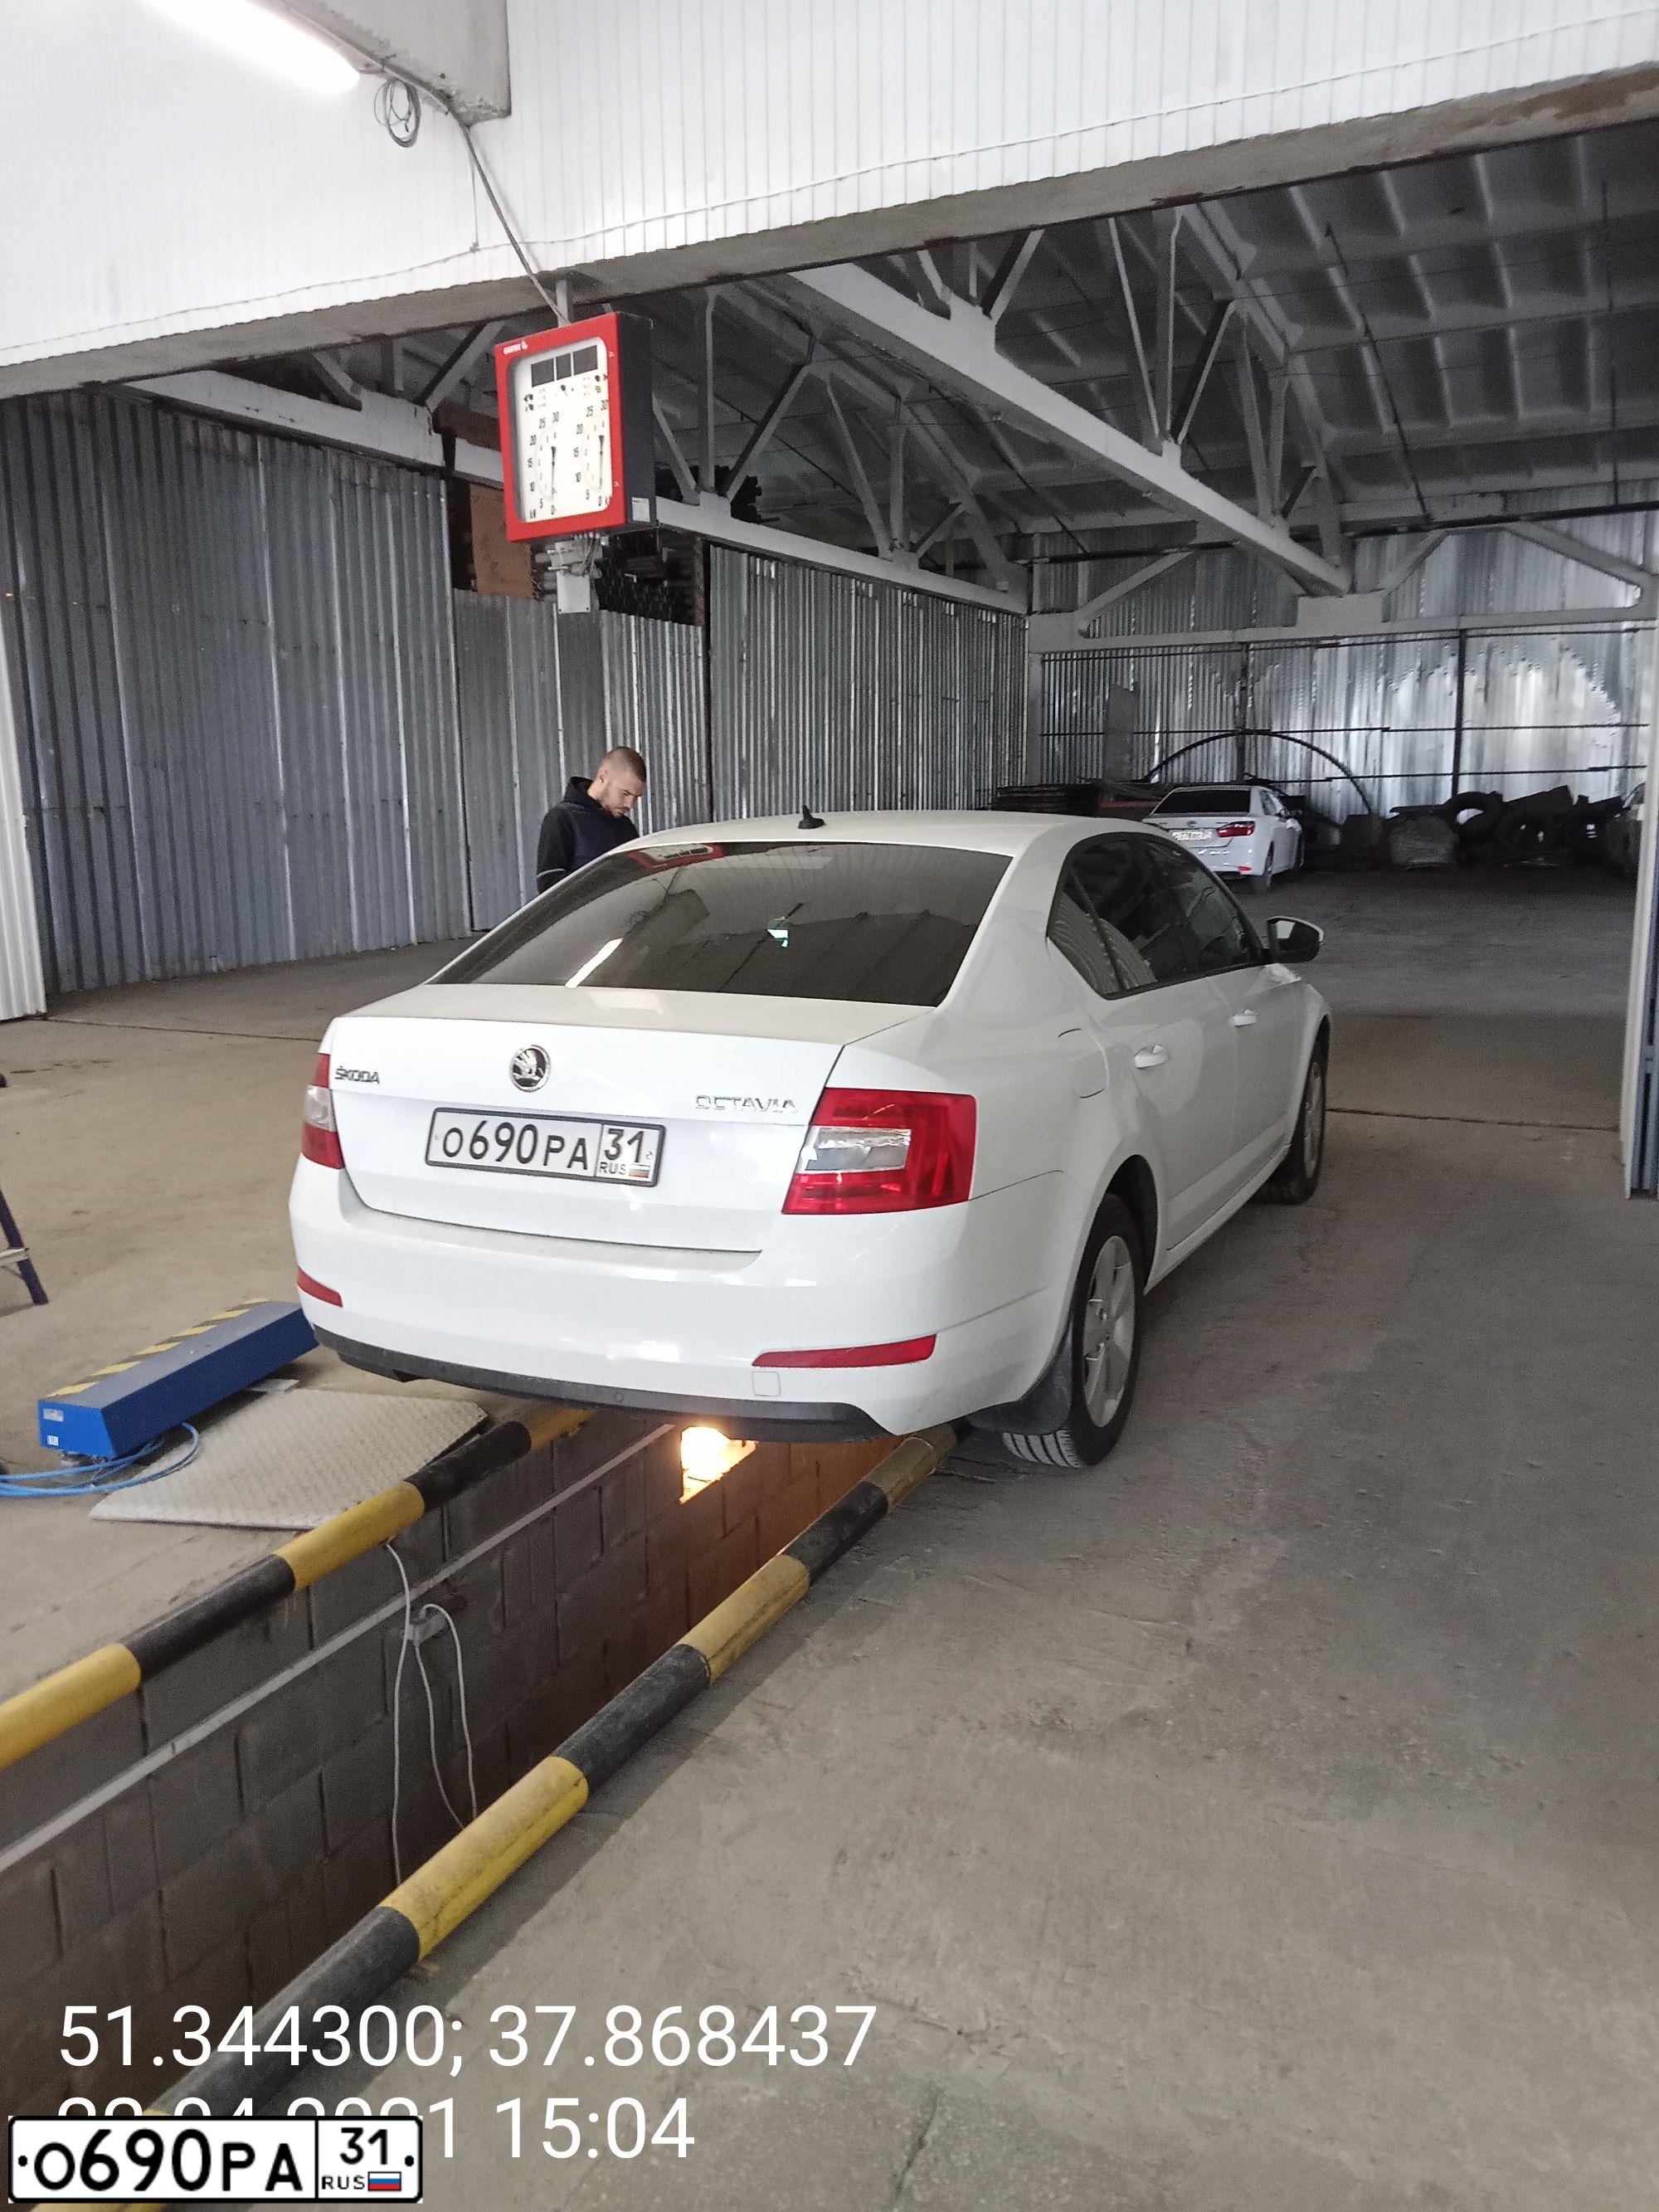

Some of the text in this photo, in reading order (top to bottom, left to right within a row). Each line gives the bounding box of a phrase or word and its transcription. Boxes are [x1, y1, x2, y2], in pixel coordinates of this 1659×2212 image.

[695, 1094, 798, 1113] OCTAVIA
[443, 1120, 645, 1170] О690РА 31
[598, 1162, 626, 1176] RUS
